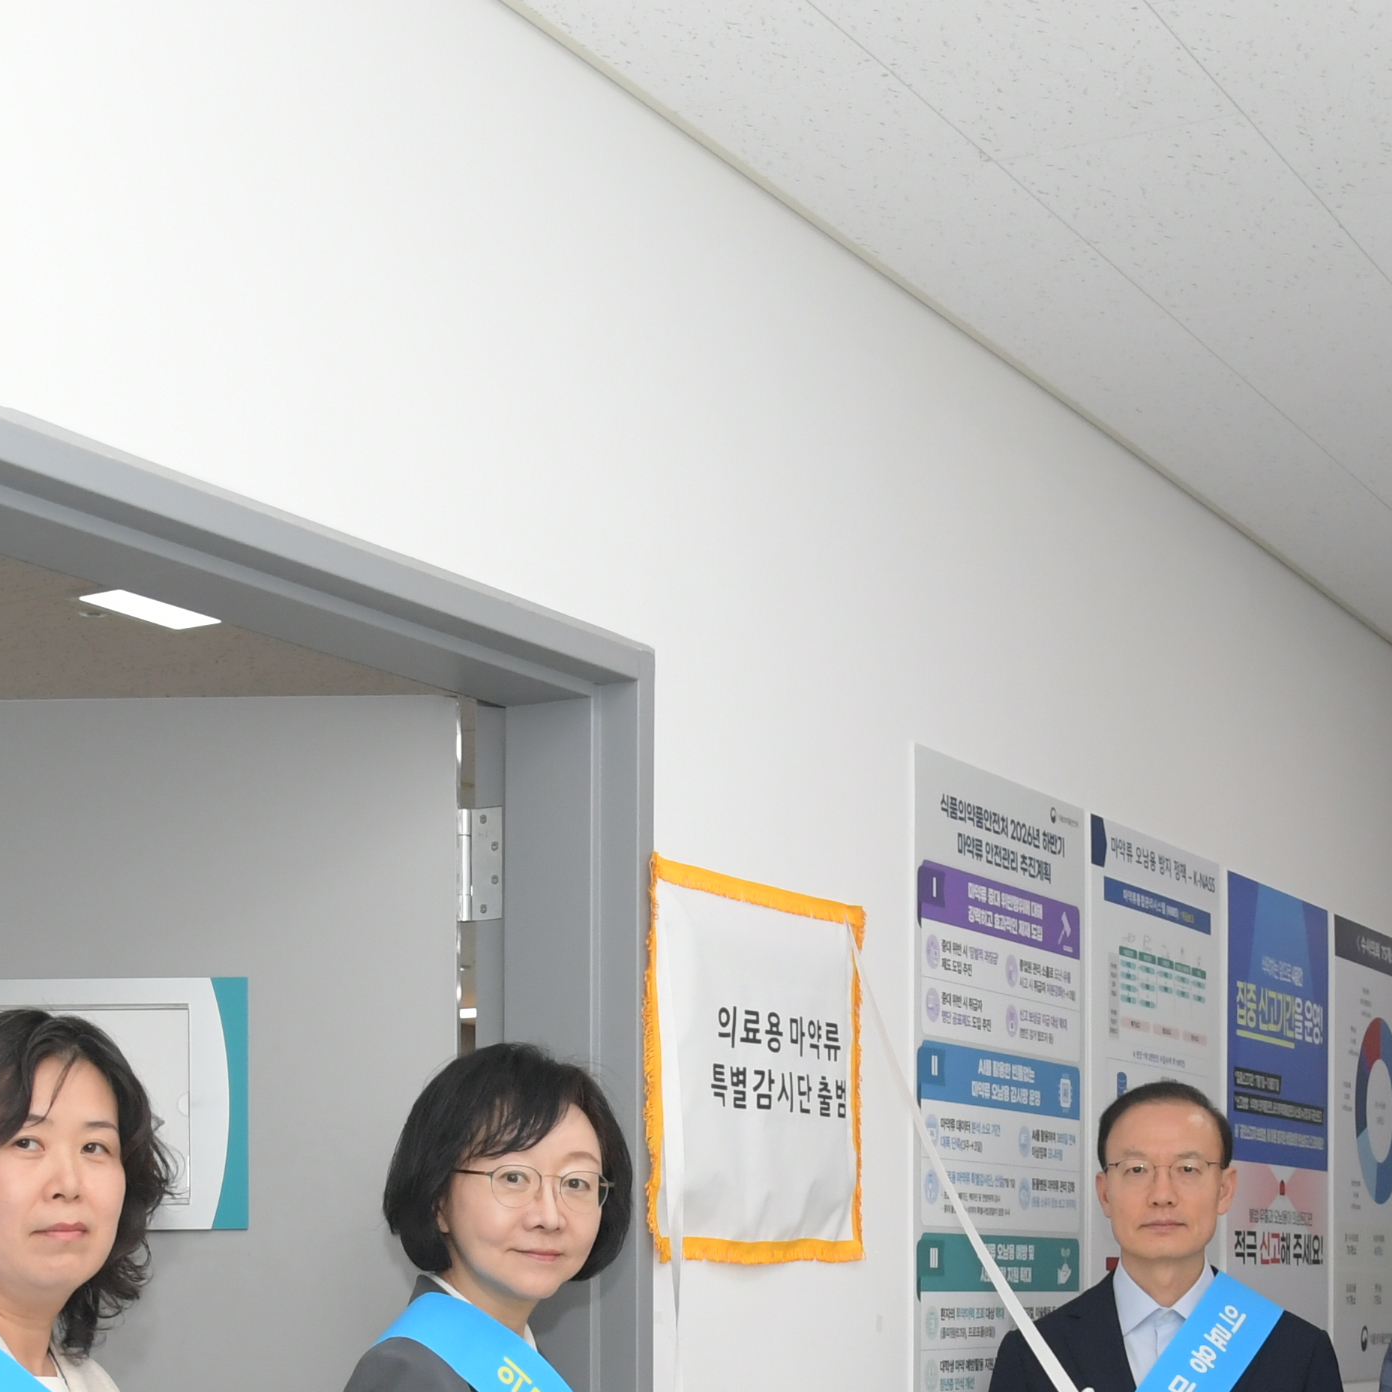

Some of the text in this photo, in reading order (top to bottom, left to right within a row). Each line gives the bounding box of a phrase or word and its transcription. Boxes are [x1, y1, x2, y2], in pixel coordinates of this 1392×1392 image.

[940, 793, 1065, 858] 식품의약품안전처 2026년 하반기
[957, 832, 1051, 884] 마약류 안전관리 추진계획
[1111, 837, 1133, 863] 마약류
[1135, 847, 1156, 872] 오남용
[1158, 854, 1172, 878] 방지
[1173, 860, 1187, 884] 정책
[1193, 870, 1215, 893] K-NASS
[968, 882, 987, 902] 마약류
[718, 1005, 841, 1062] 의료용 마약류
[1236, 980, 1257, 1028] 집중
[1258, 986, 1303, 1040] 신고기간을
[1304, 1000, 1323, 1045] 운영!
[817, 1075, 846, 1118] 출범
[971, 1080, 1041, 1107] 마약류 오남용 감시망 운영
[997, 1243, 1015, 1261] 오남용
[1234, 1230, 1257, 1265] 적극
[1260, 1231, 1291, 1265] 신고해
[1293, 1233, 1324, 1266] 주세요!
[1190, 1304, 1246, 1375] 의료용
